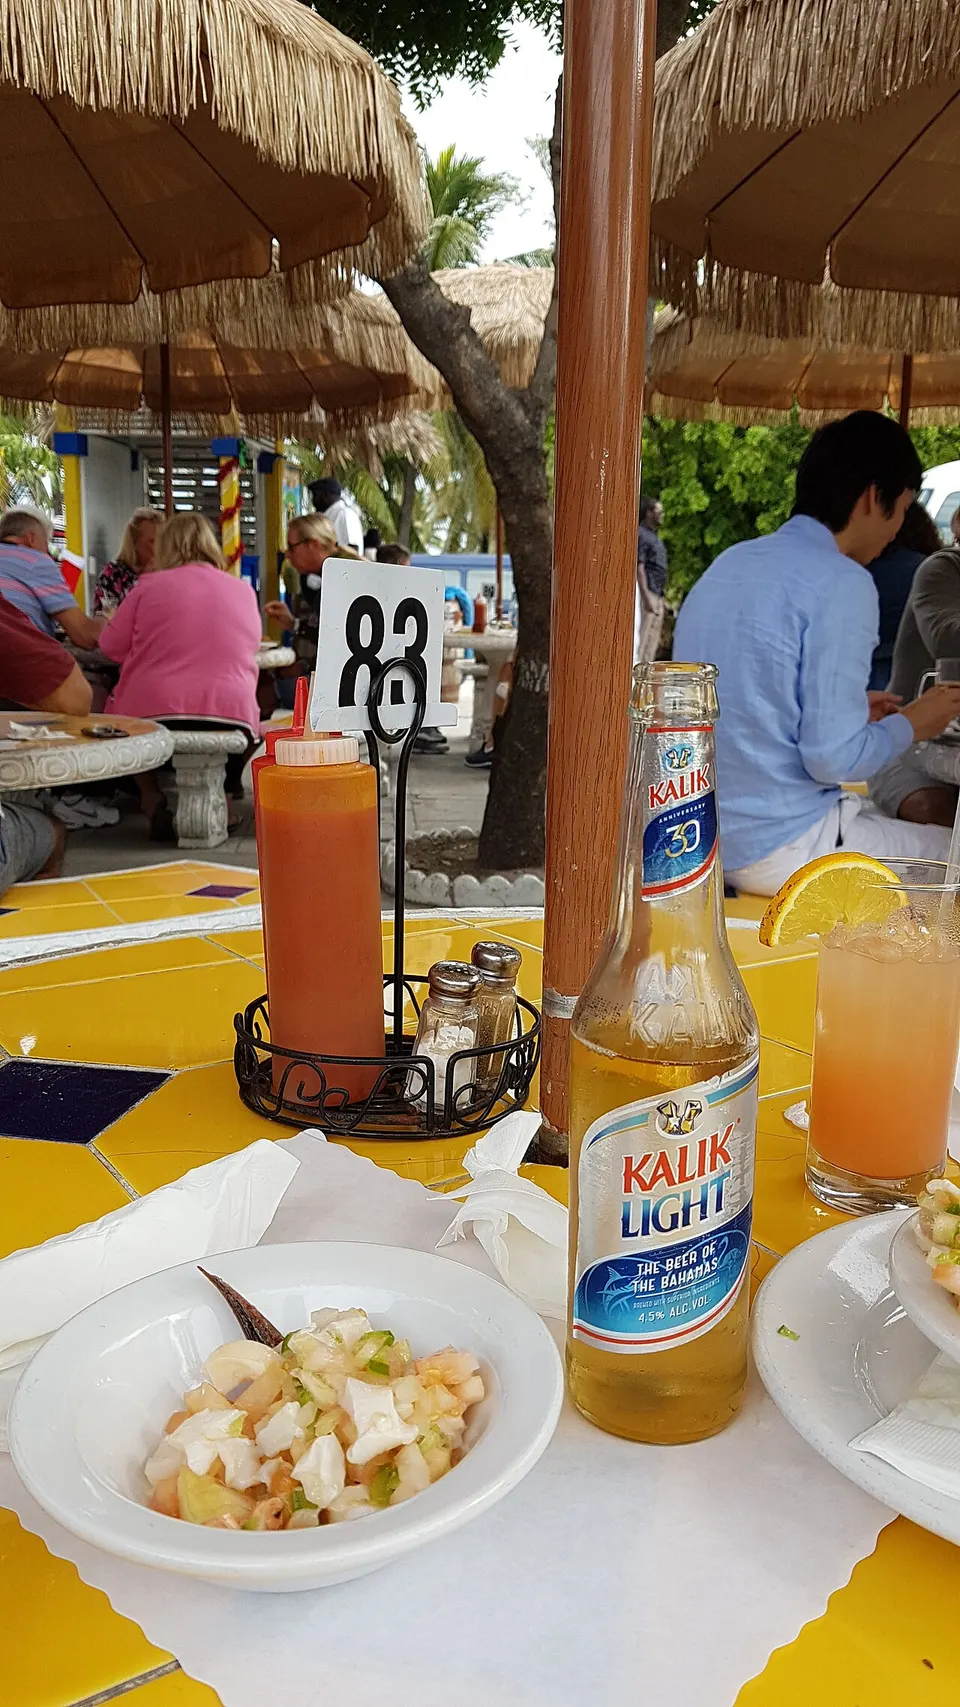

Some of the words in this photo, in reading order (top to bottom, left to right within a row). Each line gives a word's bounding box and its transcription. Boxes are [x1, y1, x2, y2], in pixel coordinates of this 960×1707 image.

[338, 595, 429, 708] 83
[649, 763, 709, 809] KALIK
[658, 802, 707, 824] ANNIVERSARY
[664, 819, 701, 858] 30
[622, 1122, 734, 1194] KALIK
[621, 1173, 730, 1237] LIGHT
[633, 1278, 656, 1293] THE
[661, 1257, 718, 1289] BAHAMAS
[637, 1261, 660, 1276] THE
[665, 1251, 697, 1272] BEER
[702, 1241, 716, 1258] OF
[638, 1311, 665, 1323] 4.5%
